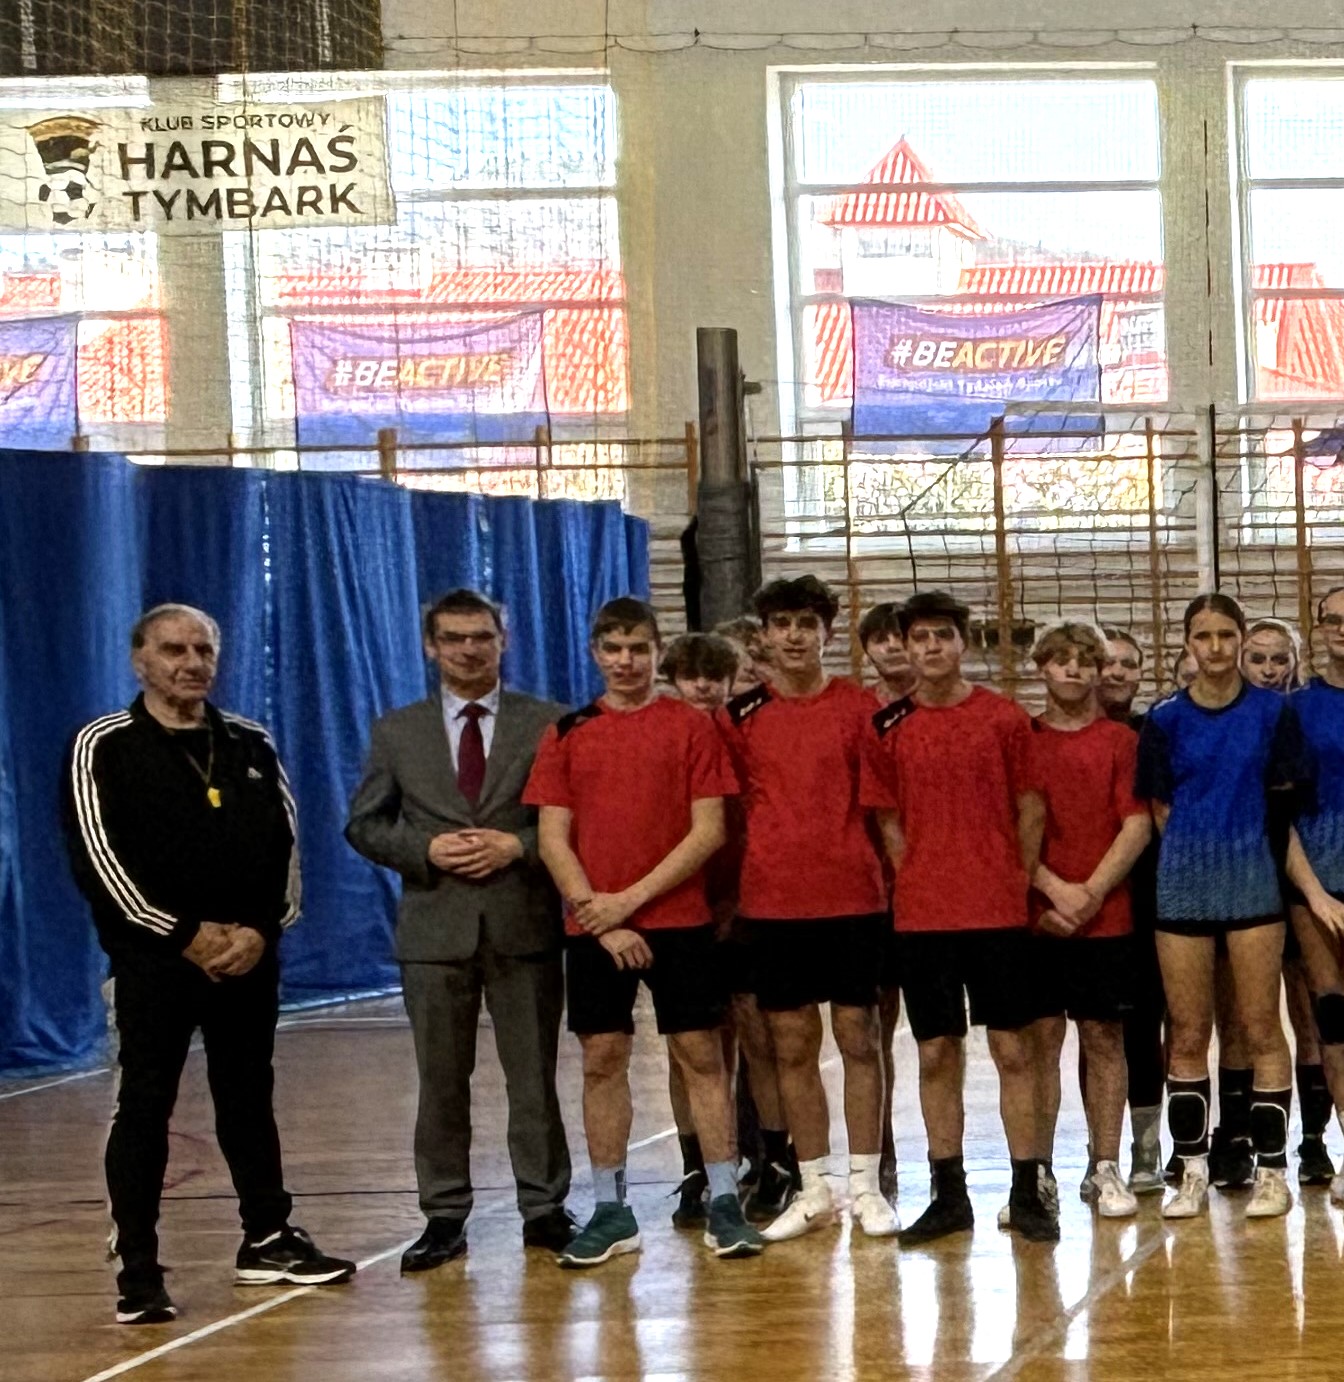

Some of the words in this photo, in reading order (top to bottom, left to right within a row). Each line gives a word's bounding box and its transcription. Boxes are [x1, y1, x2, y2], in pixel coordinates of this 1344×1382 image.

[140, 116, 194, 132] KLUB
[201, 112, 332, 130] SPORTOWY
[117, 123, 359, 181] HARNAŚ
[122, 181, 365, 222] TYMBARK
[890, 333, 1066, 370] #BEACTIVE
[332, 355, 504, 387] #BEACTIVE
